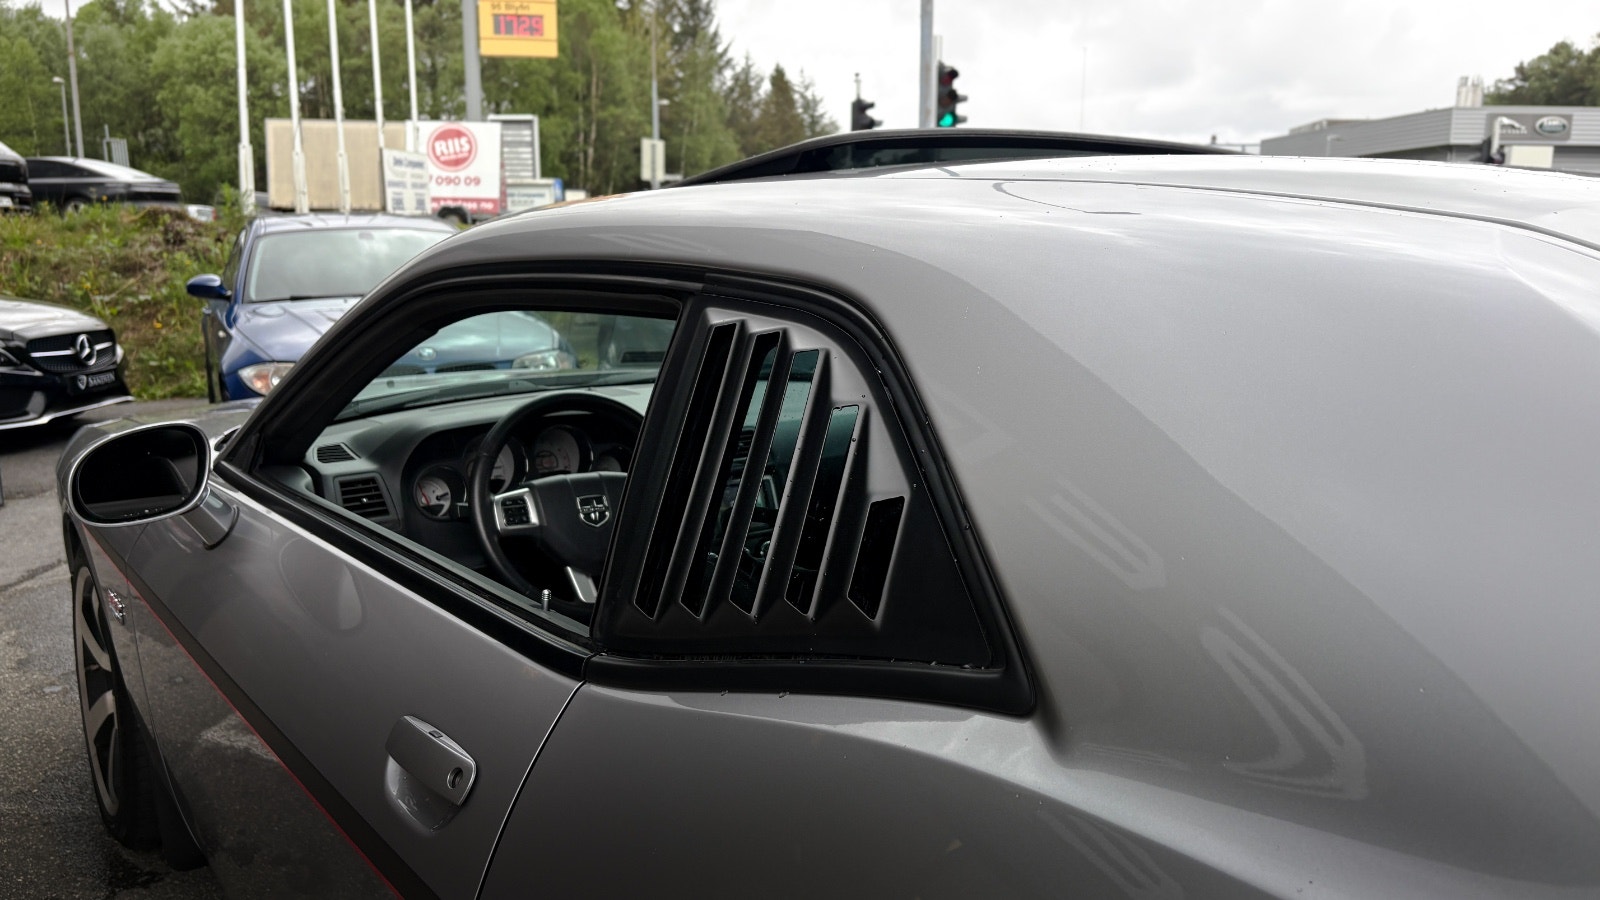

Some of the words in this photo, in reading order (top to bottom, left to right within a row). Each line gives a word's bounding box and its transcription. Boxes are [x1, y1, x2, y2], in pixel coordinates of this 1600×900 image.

[434, 136, 471, 157] RIIS
[436, 175, 461, 186] 090
[464, 175, 481, 186] 09
